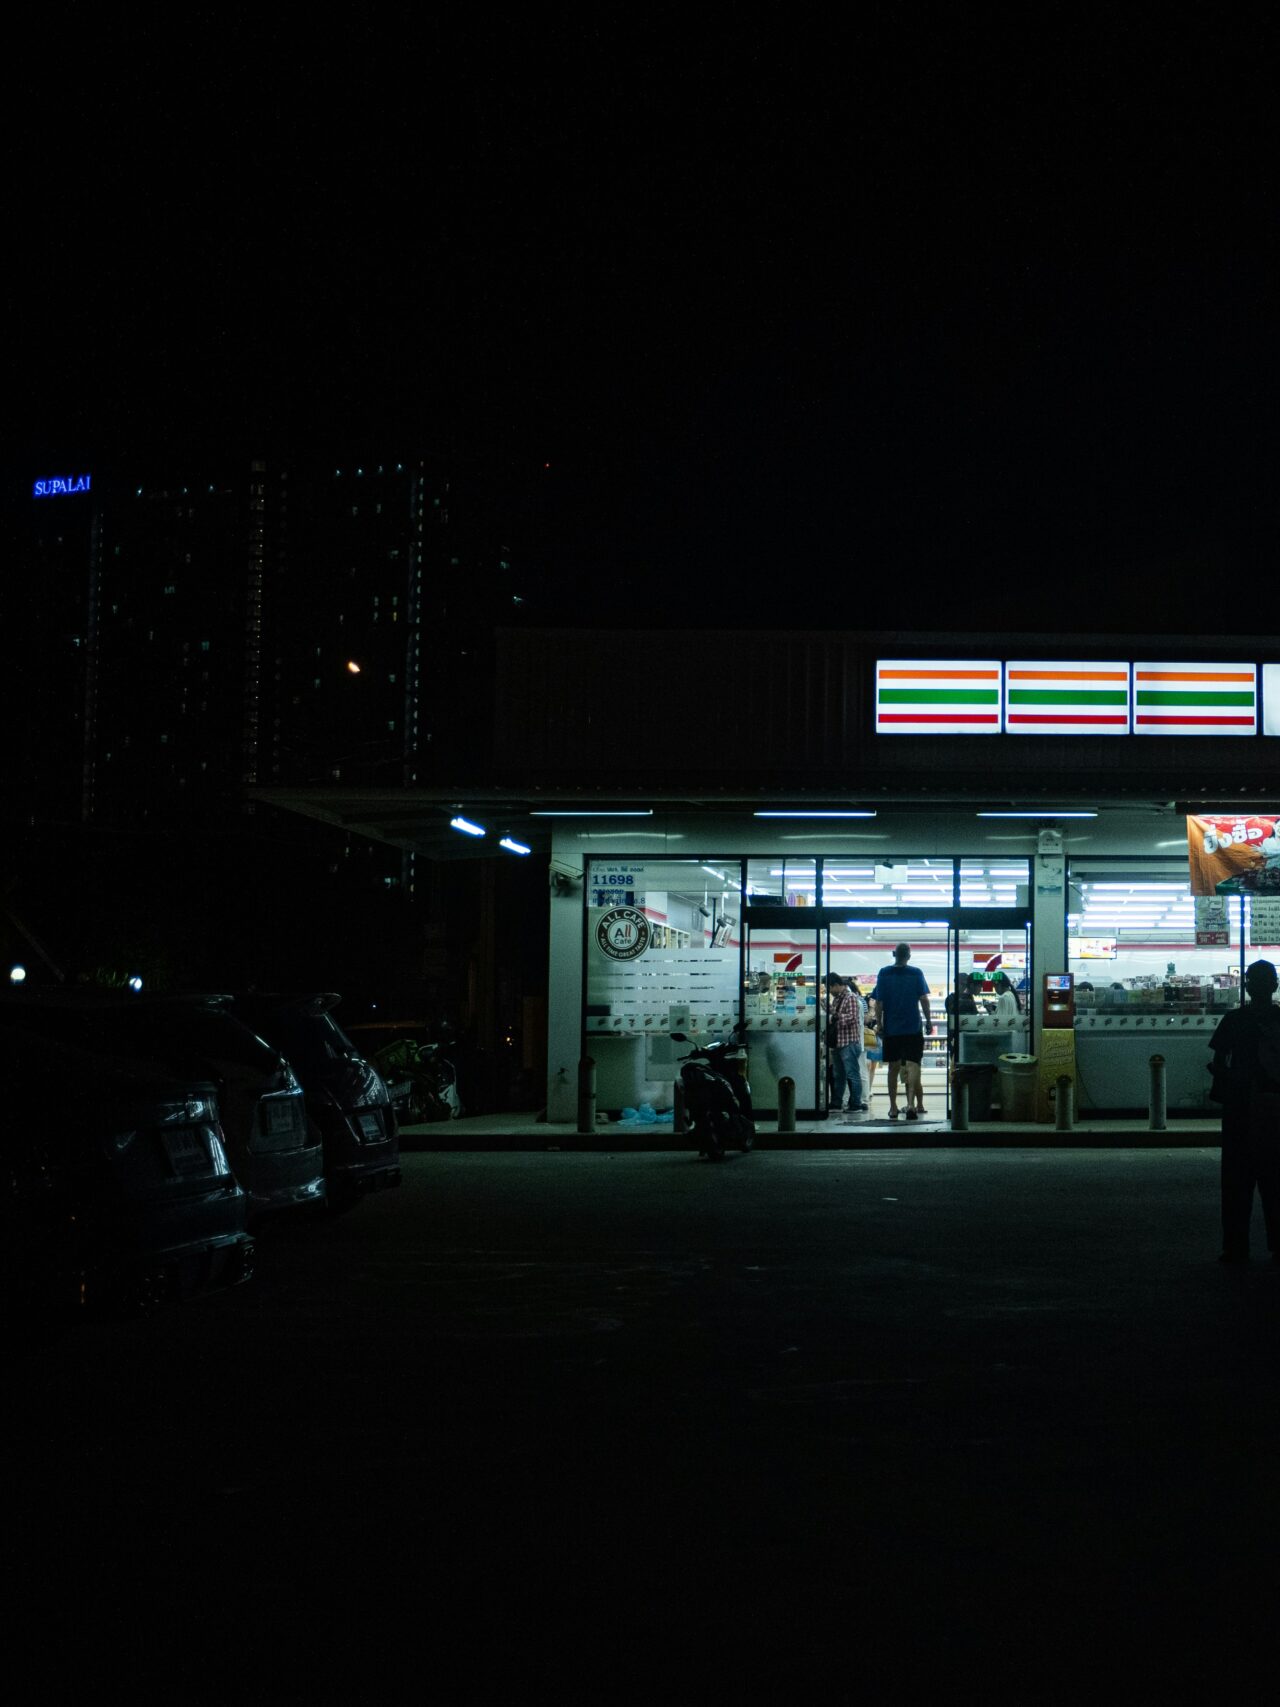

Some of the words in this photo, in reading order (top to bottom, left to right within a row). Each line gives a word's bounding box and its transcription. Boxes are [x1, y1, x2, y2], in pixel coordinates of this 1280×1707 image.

[35, 476, 91, 495] SUPALAI
[592, 874, 634, 885] 11698
[602, 912, 621, 929] ALL
